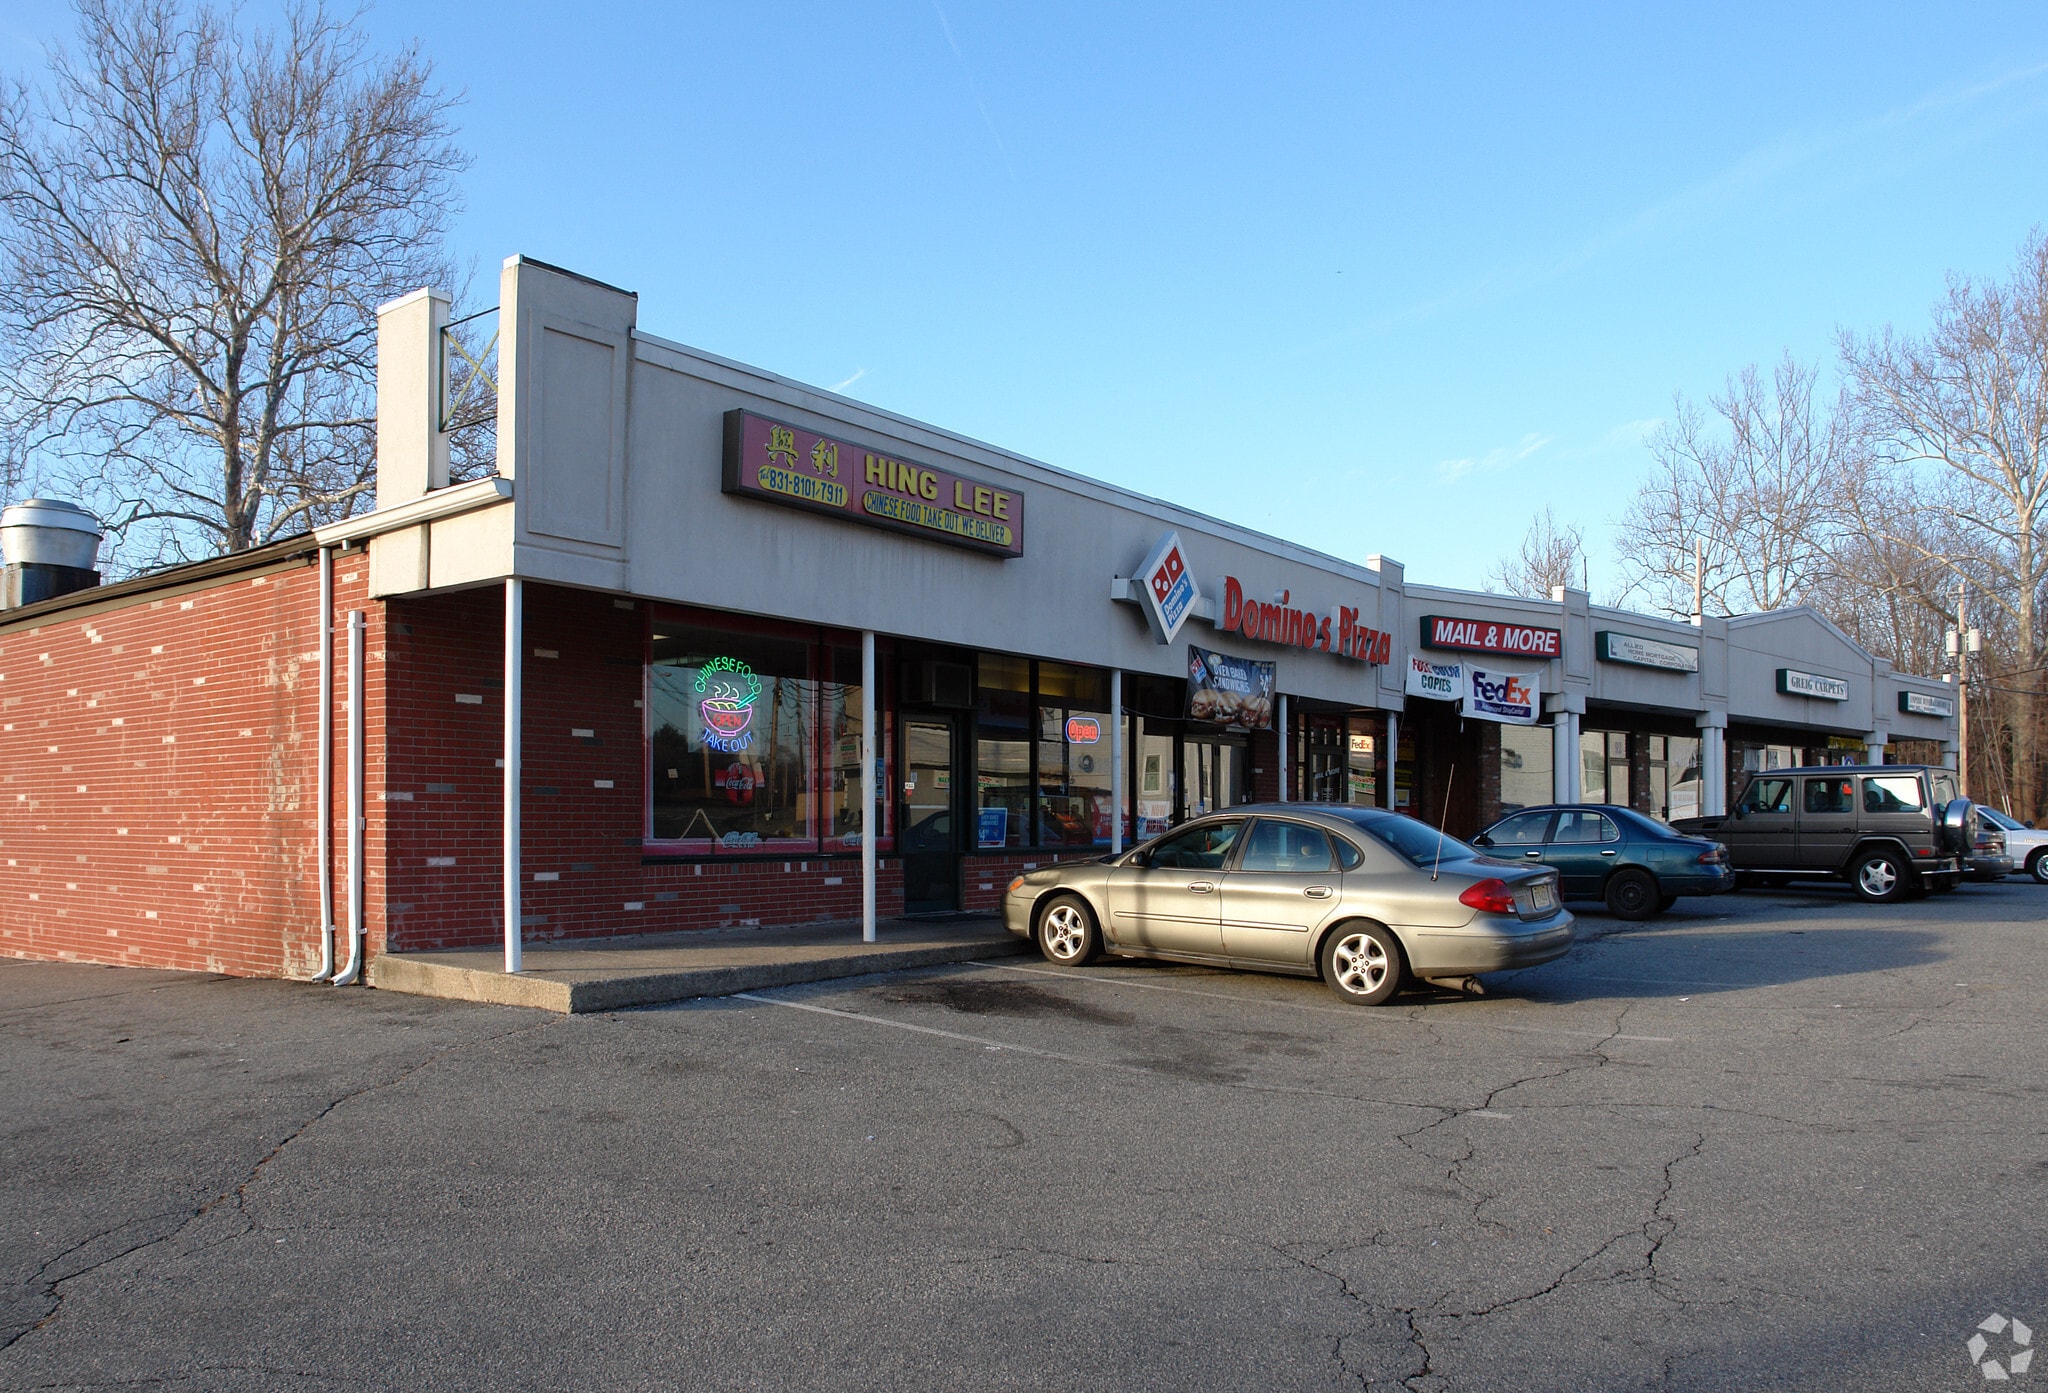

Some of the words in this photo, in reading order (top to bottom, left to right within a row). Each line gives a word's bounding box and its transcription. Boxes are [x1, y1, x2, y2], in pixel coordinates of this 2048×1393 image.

[865, 454, 938, 500] HING
[955, 481, 1010, 521] LEE
[866, 492, 898, 517] CHINESE
[901, 501, 920, 522] FOOD
[923, 506, 942, 528] TAKE
[945, 512, 959, 532] OUT
[962, 516, 973, 536] WE
[976, 520, 1005, 543] DELIVER
[1163, 578, 1188, 615] Domino's
[1168, 601, 1183, 626] Pizza
[1339, 605, 1391, 665] Pizza
[1435, 620, 1481, 646] MAIL
[1484, 626, 1498, 648] &
[1503, 628, 1558, 653] MORE
[1623, 642, 1643, 650] ALLIED
[1412, 657, 1432, 673] FULL
[1632, 655, 1655, 664] CAPITAL
[1646, 652, 1675, 661] MORTGAGE
[694, 656, 735, 693] CHINESE
[736, 661, 762, 694] FOOD
[1213, 664, 1230, 677] OVEN
[1421, 674, 1451, 692] COPIES
[1472, 671, 1531, 705] FedEx
[1815, 680, 1844, 695] CARPETS
[713, 713, 742, 727] OPEN
[1068, 719, 1098, 743] Open
[702, 727, 728, 752] TAKE
[731, 731, 754, 752] OUT
[1351, 738, 1370, 750] FedEx
